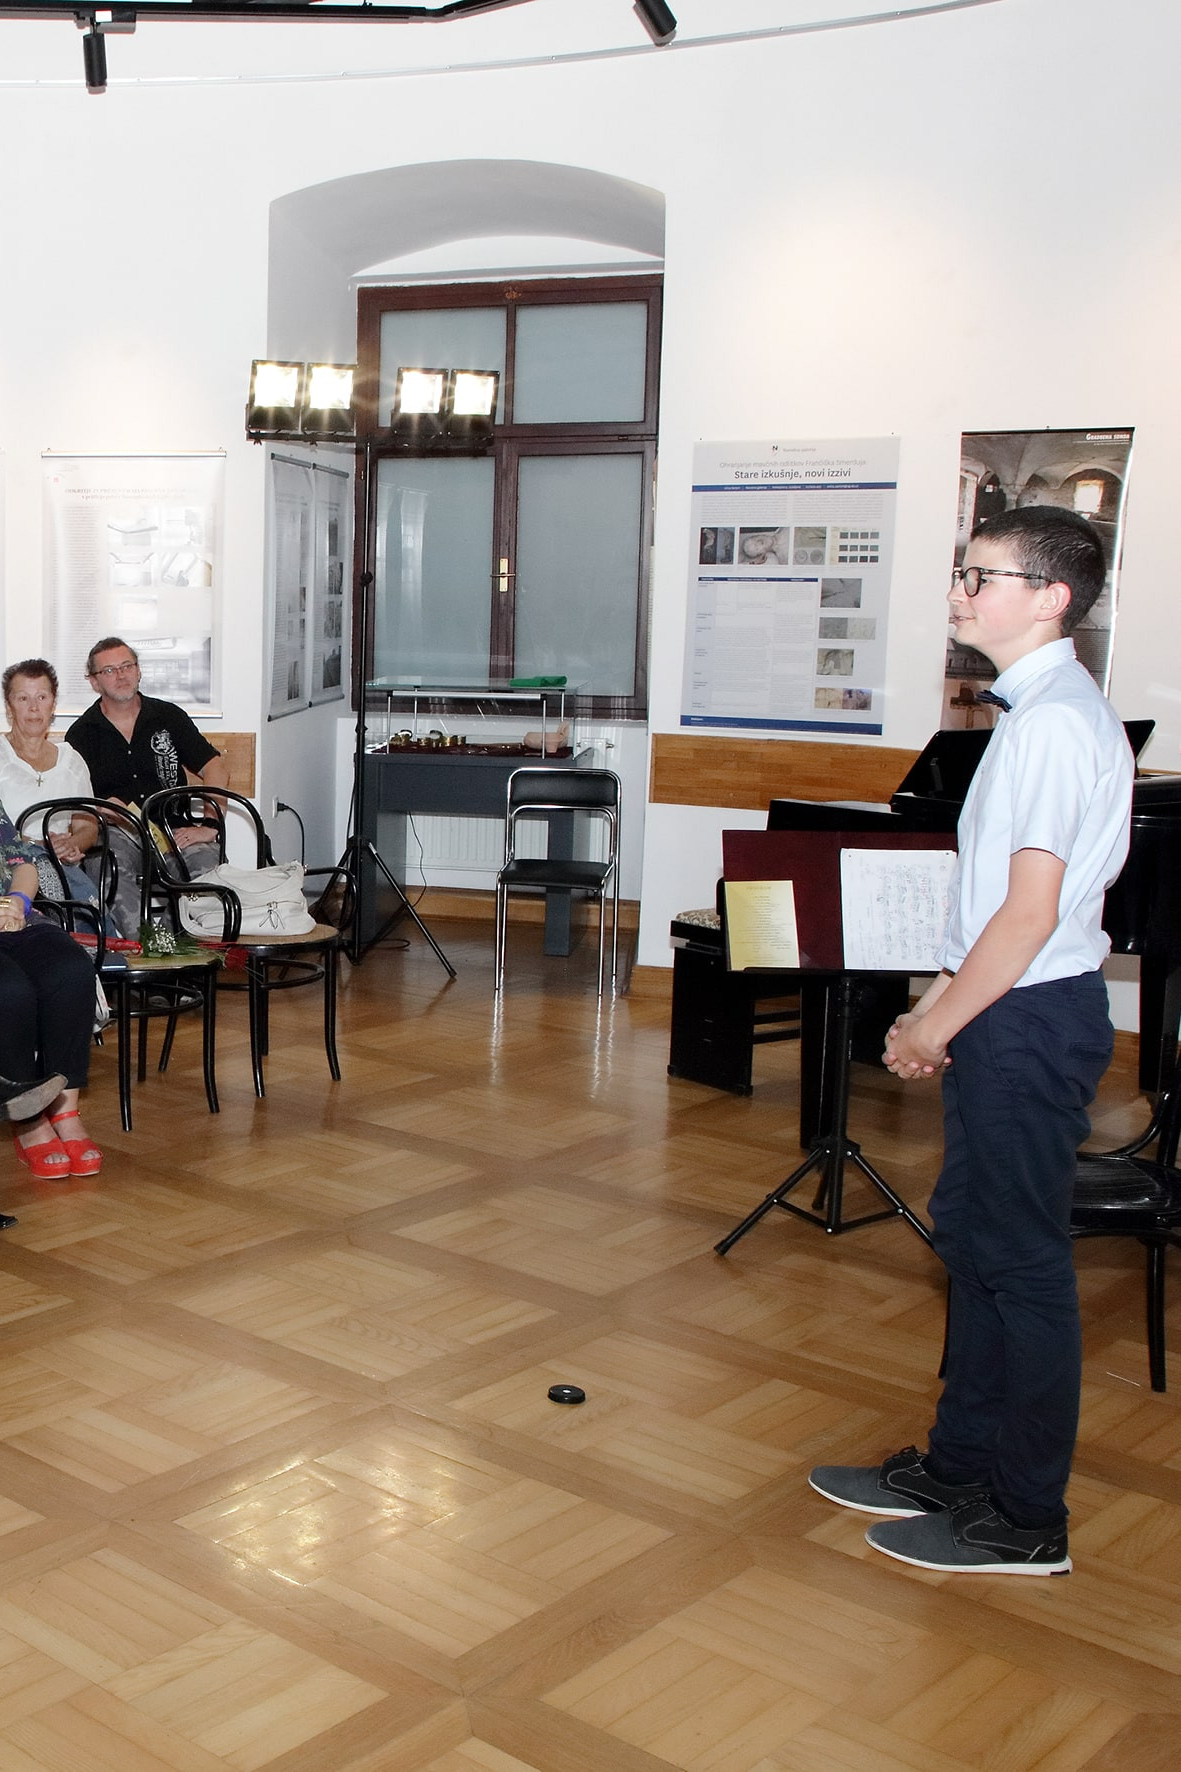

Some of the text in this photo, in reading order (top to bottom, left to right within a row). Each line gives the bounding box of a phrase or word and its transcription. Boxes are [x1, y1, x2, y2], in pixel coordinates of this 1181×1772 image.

[734, 467, 852, 481] Stare izkušnje, novi izzivi
